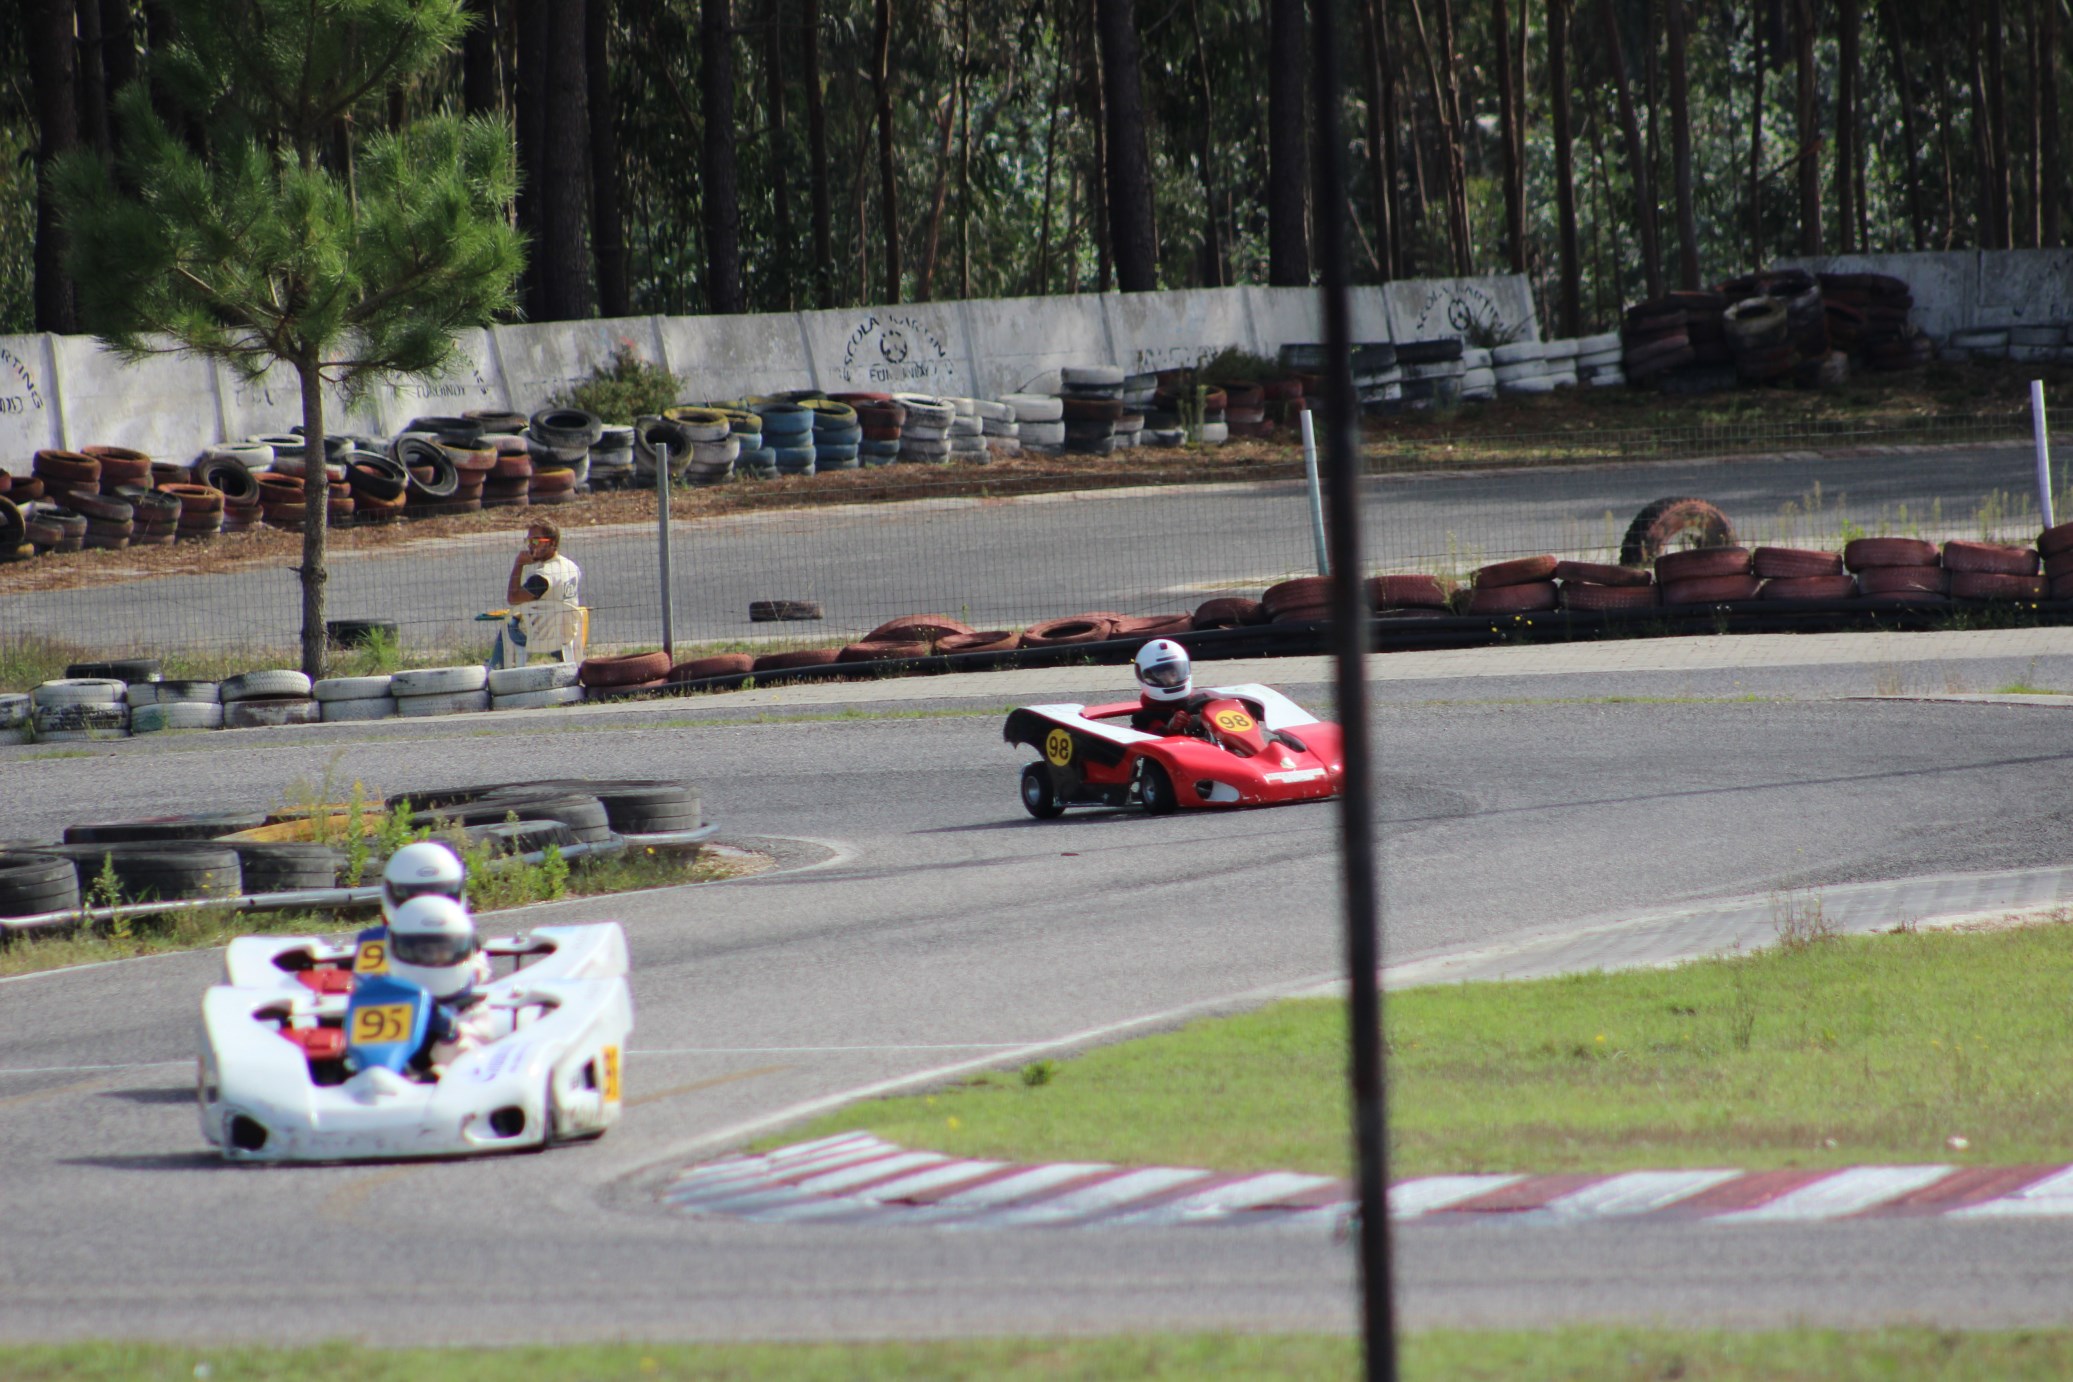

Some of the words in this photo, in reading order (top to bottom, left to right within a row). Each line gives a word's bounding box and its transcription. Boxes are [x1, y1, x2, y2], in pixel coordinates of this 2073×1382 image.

[1220, 714, 1250, 729] 98
[1049, 735, 1070, 761] 98
[363, 944, 385, 970] 9
[360, 1007, 403, 1040] 95
